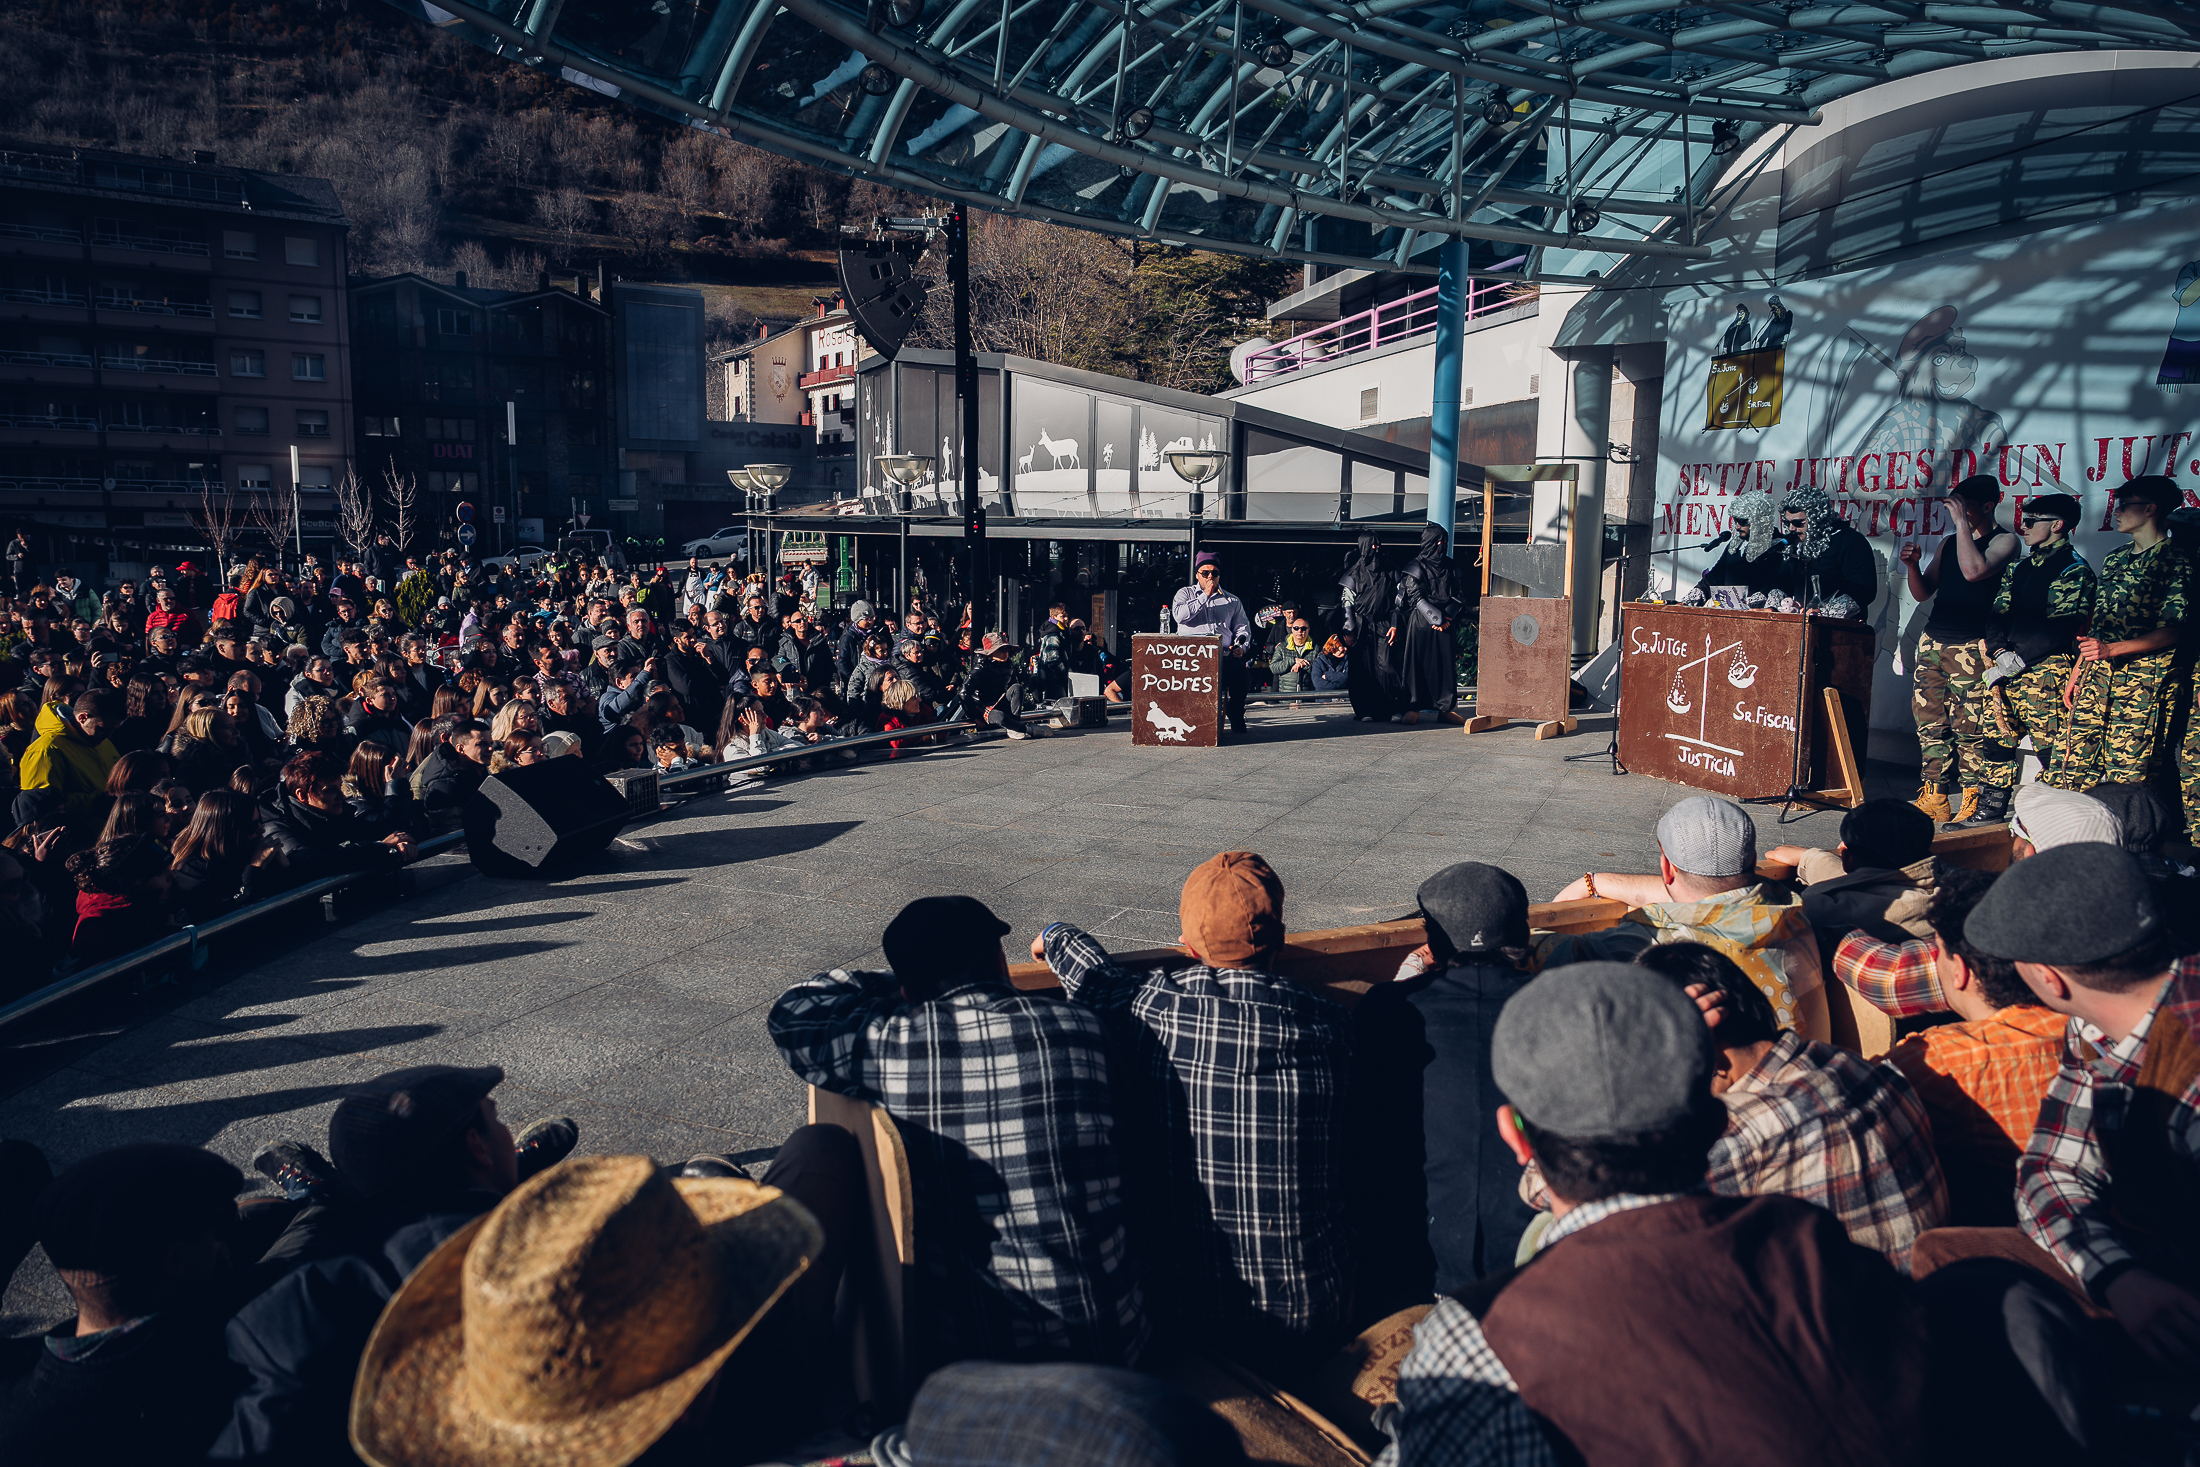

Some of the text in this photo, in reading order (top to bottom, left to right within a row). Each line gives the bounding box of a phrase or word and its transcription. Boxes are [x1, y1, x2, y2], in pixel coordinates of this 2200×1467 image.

[746, 431, 802, 449] Català
[433, 443, 476, 459] DUAT
[1678, 459, 1776, 497] SETZE
[1786, 448, 1935, 493] JUTGES
[1947, 443, 2067, 489] D'UN
[1831, 497, 1948, 537] ETGE
[1145, 643, 1219, 659] ADVOCAT
[1161, 659, 1201, 672] DELS
